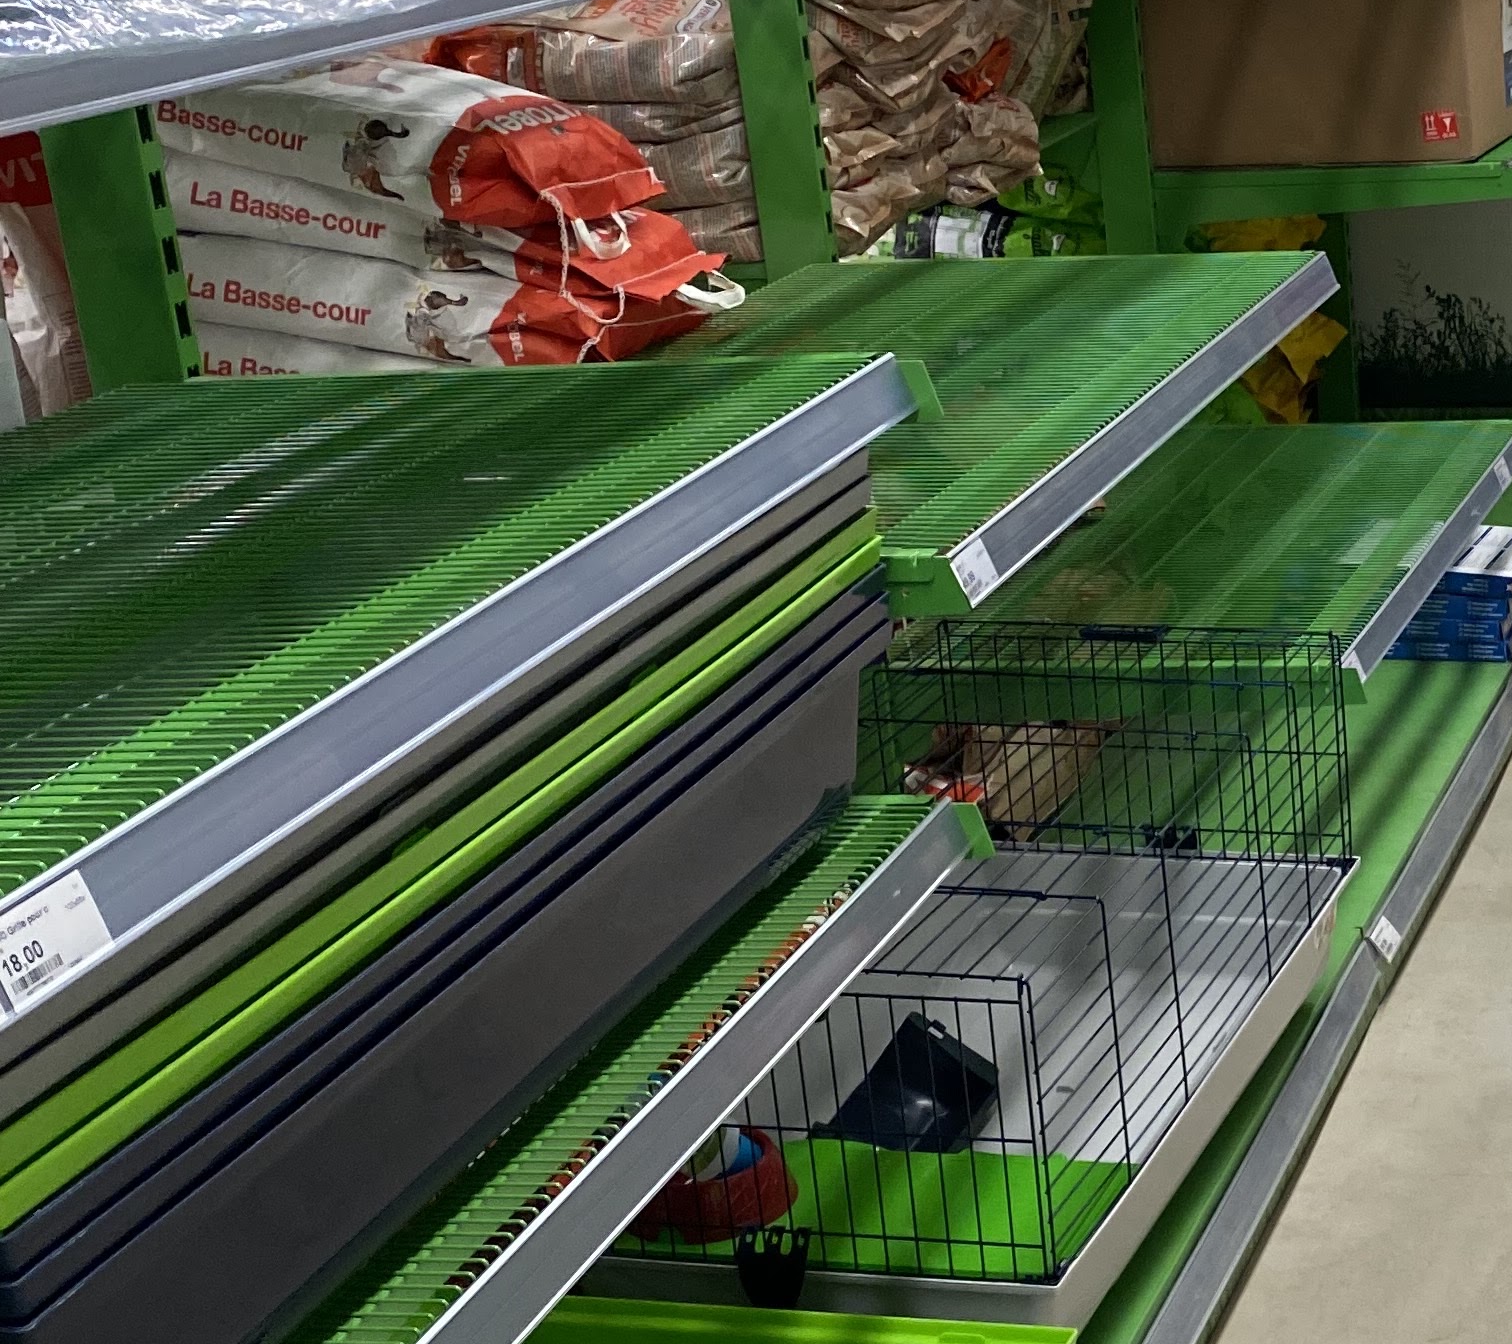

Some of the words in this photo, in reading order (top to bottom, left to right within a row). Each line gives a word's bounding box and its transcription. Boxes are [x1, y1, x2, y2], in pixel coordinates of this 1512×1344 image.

[156, 100, 310, 152] Basse-cour
[190, 181, 223, 209] La
[230, 189, 387, 239] Basse-cour
[187, 273, 217, 300] La
[223, 280, 373, 327] Basse-cour
[2, 940, 44, 978] 18,00
